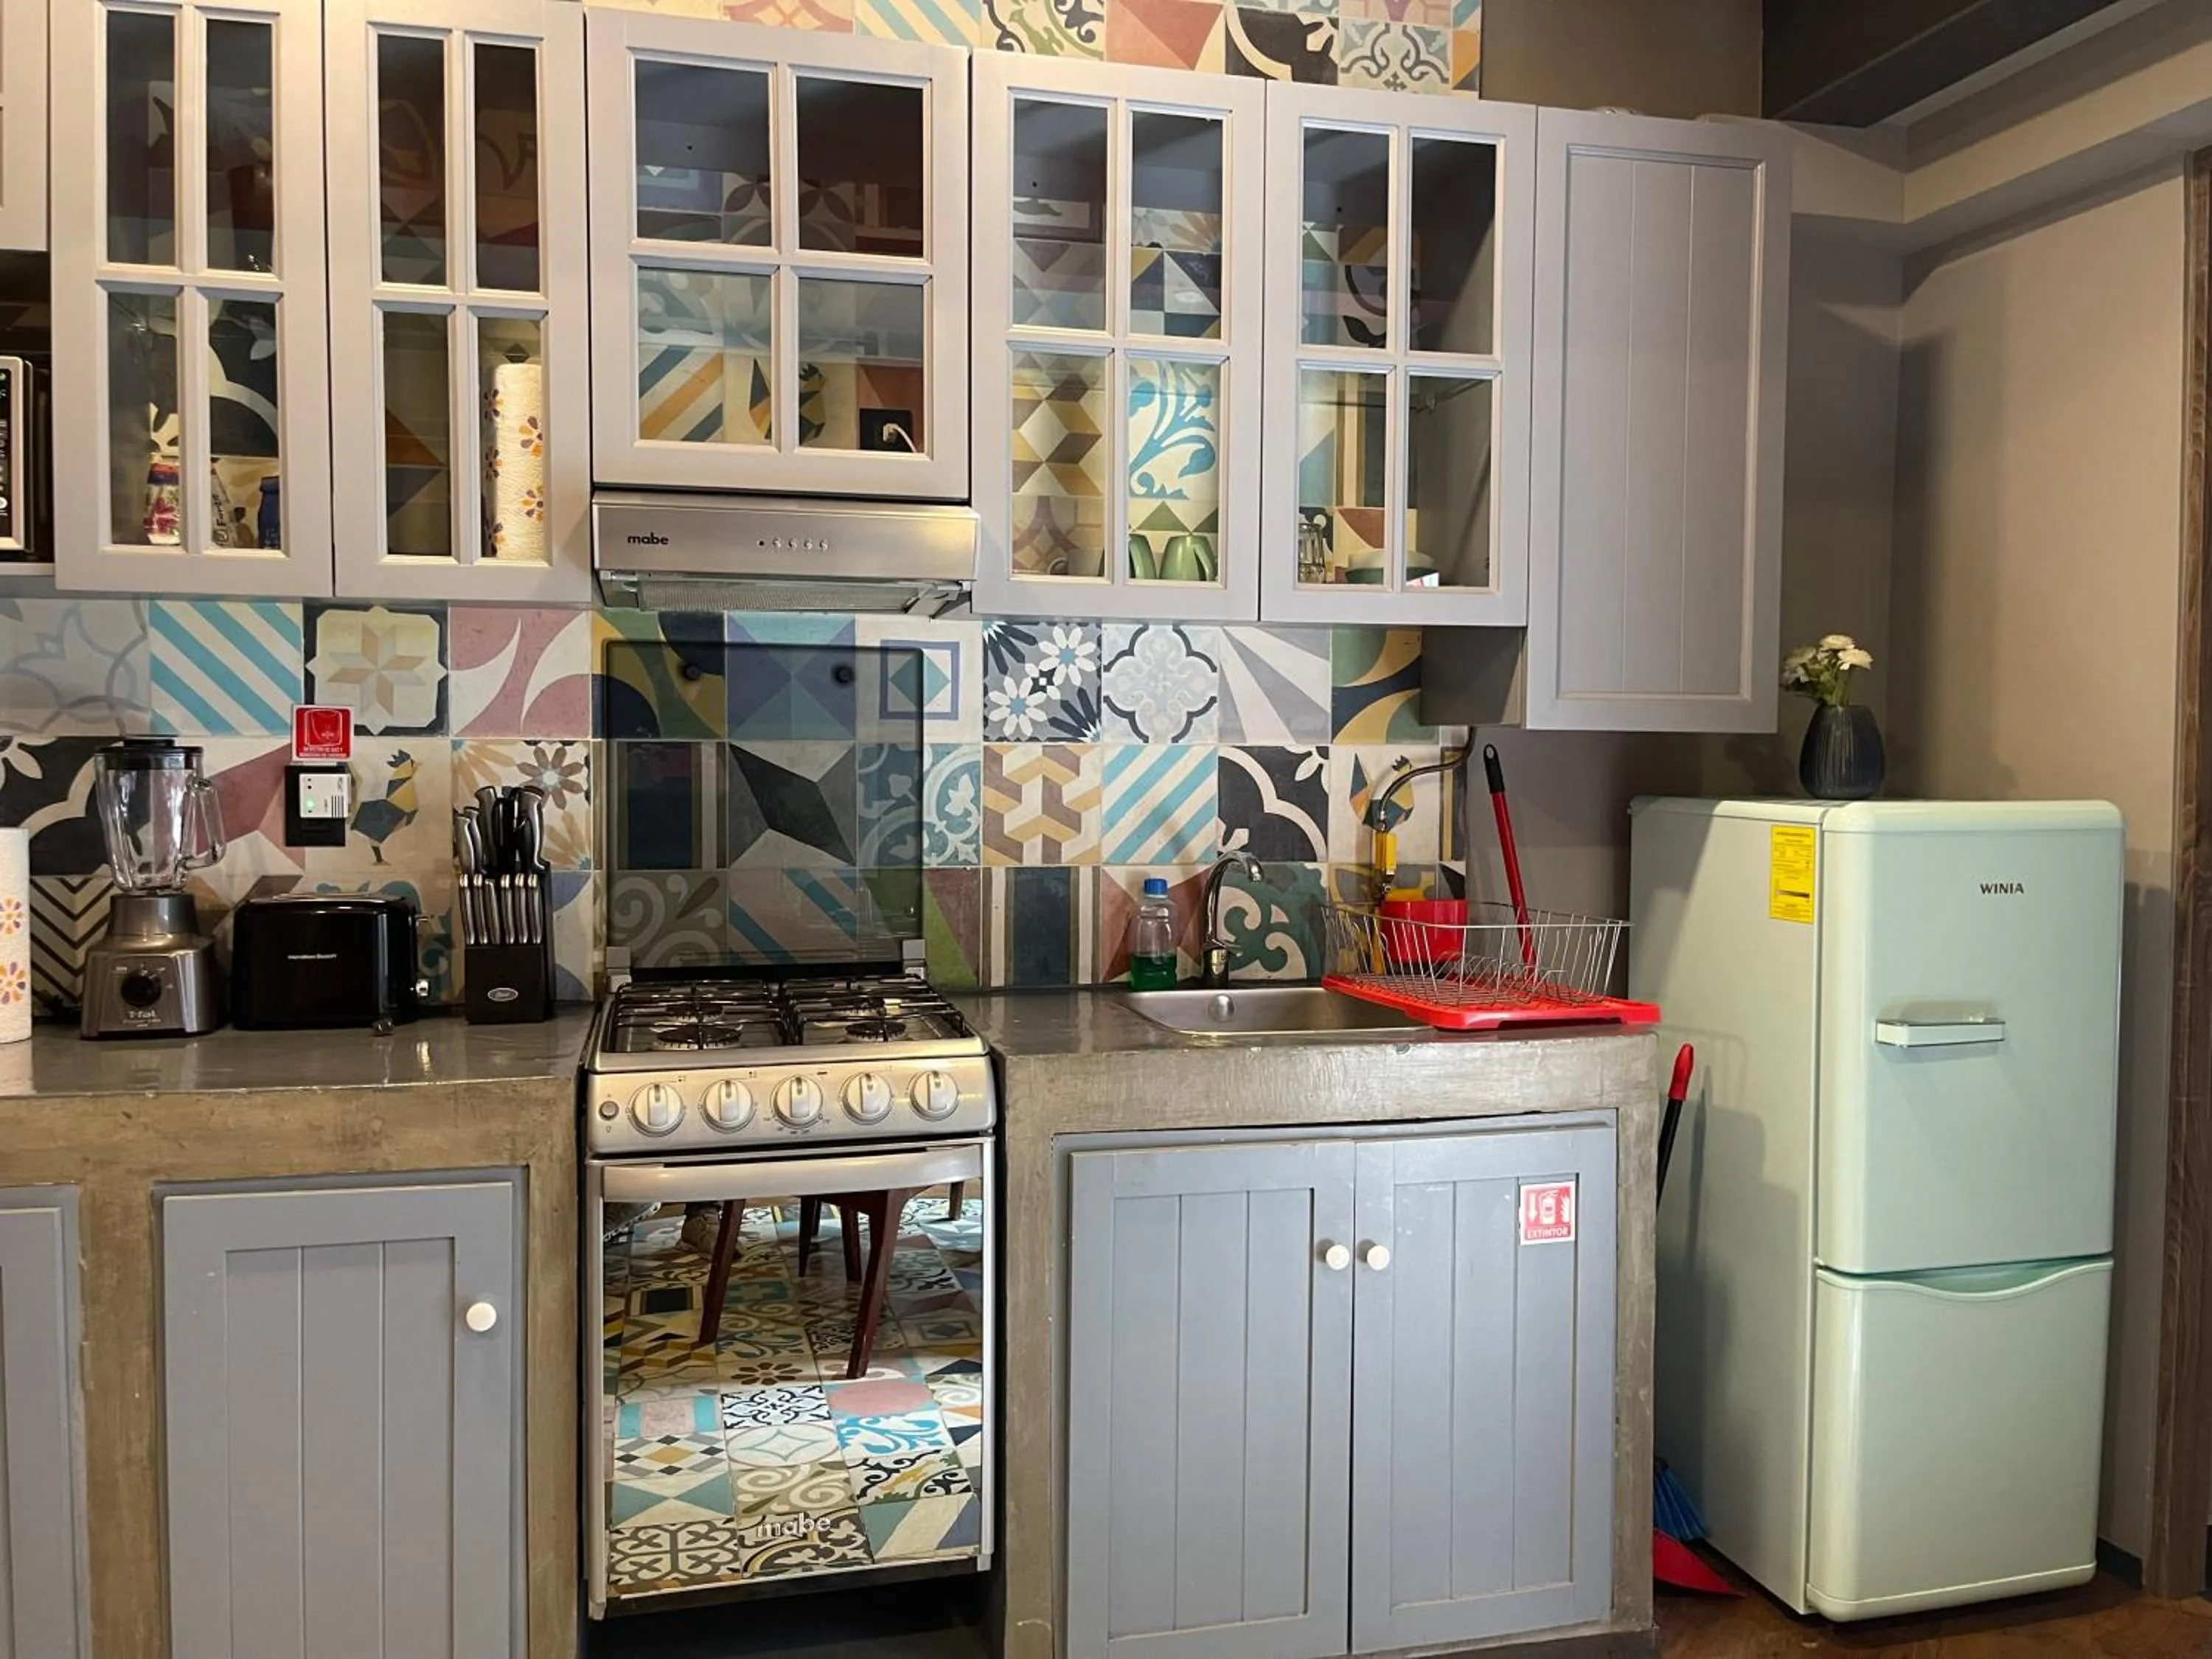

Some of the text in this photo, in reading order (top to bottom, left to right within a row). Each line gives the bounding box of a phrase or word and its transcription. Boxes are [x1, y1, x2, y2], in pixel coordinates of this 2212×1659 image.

[627, 532, 669, 545] mabe
[1979, 883, 2024, 894] WINIA
[1527, 1226, 1569, 1239] EXTINTOR
[757, 1512, 831, 1538] mabe
